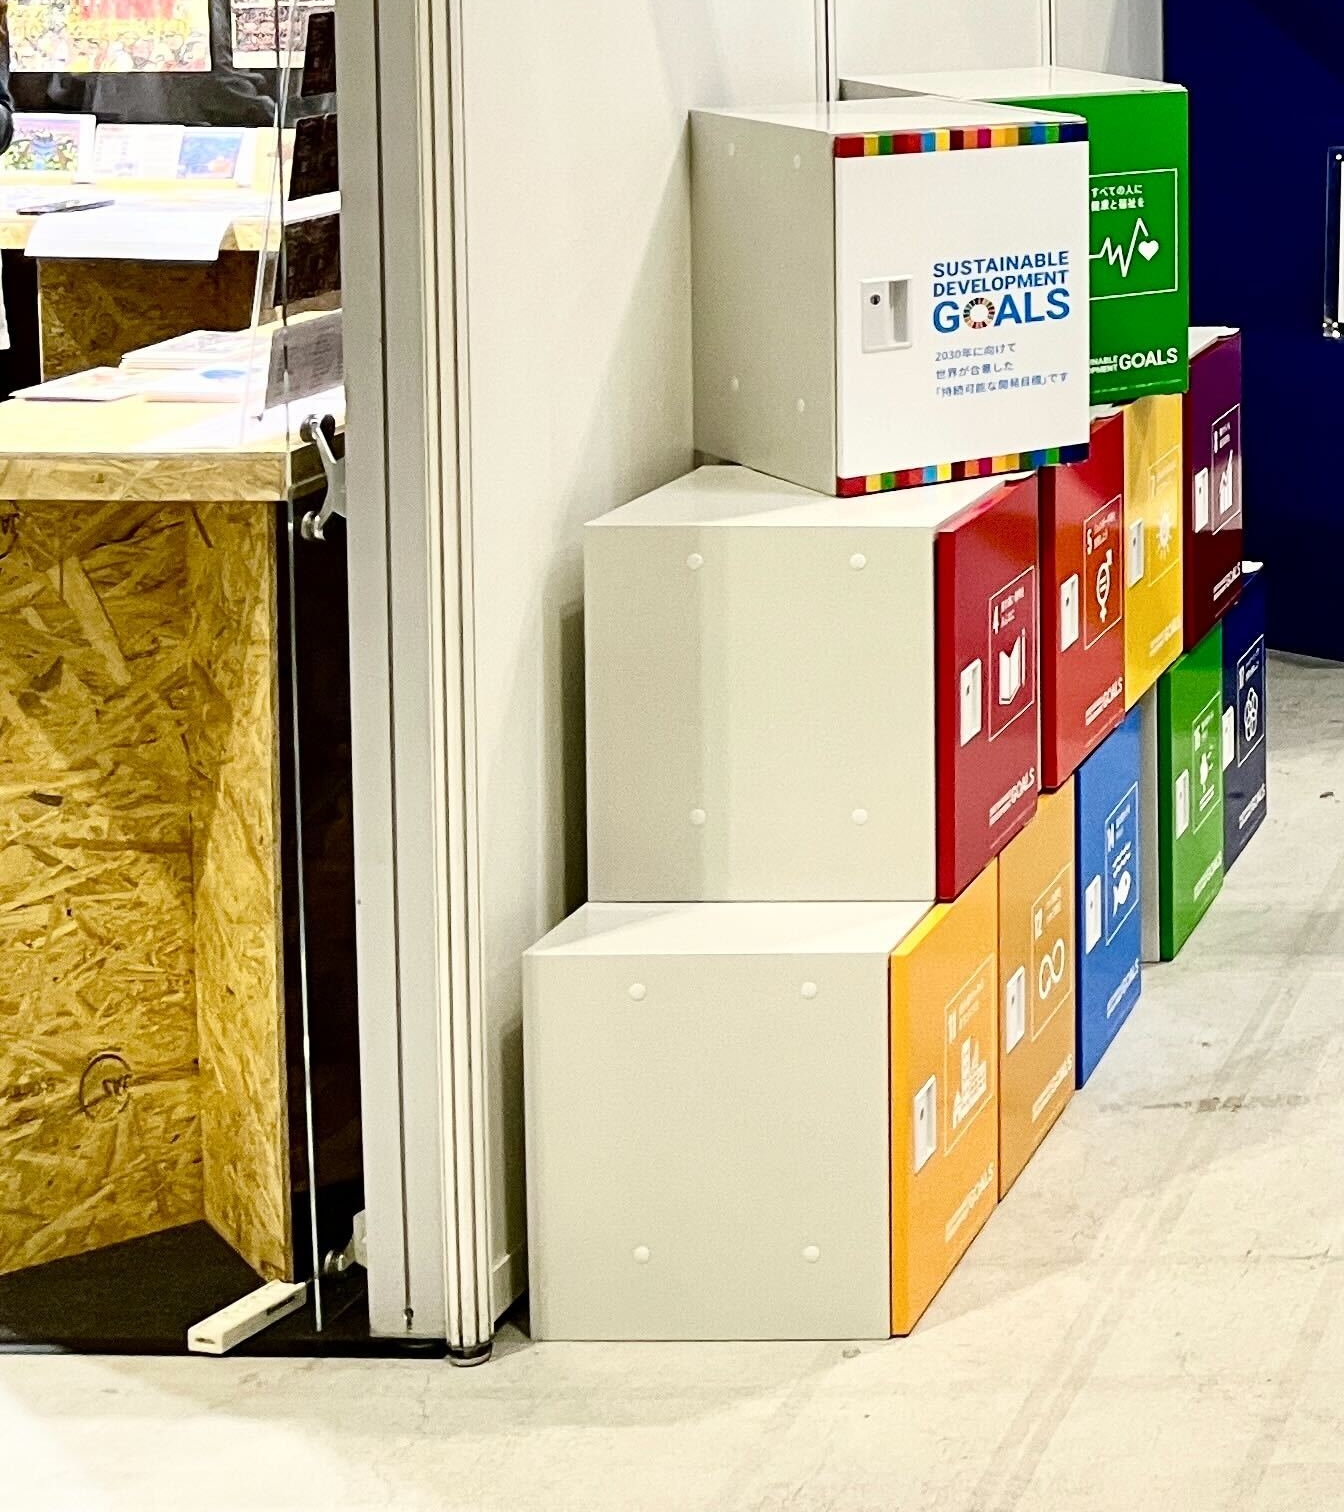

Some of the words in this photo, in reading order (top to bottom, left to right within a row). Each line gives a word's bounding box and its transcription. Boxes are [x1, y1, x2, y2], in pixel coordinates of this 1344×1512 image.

[1090, 184, 1143, 199] すべての人に
[933, 250, 1069, 278] SUSTAINABLE
[933, 269, 1069, 297] DEVELOPMENT
[933, 287, 1070, 334] GOALS
[935, 342, 1017, 362] 2030年に向けて
[1119, 347, 1178, 371] GOALS
